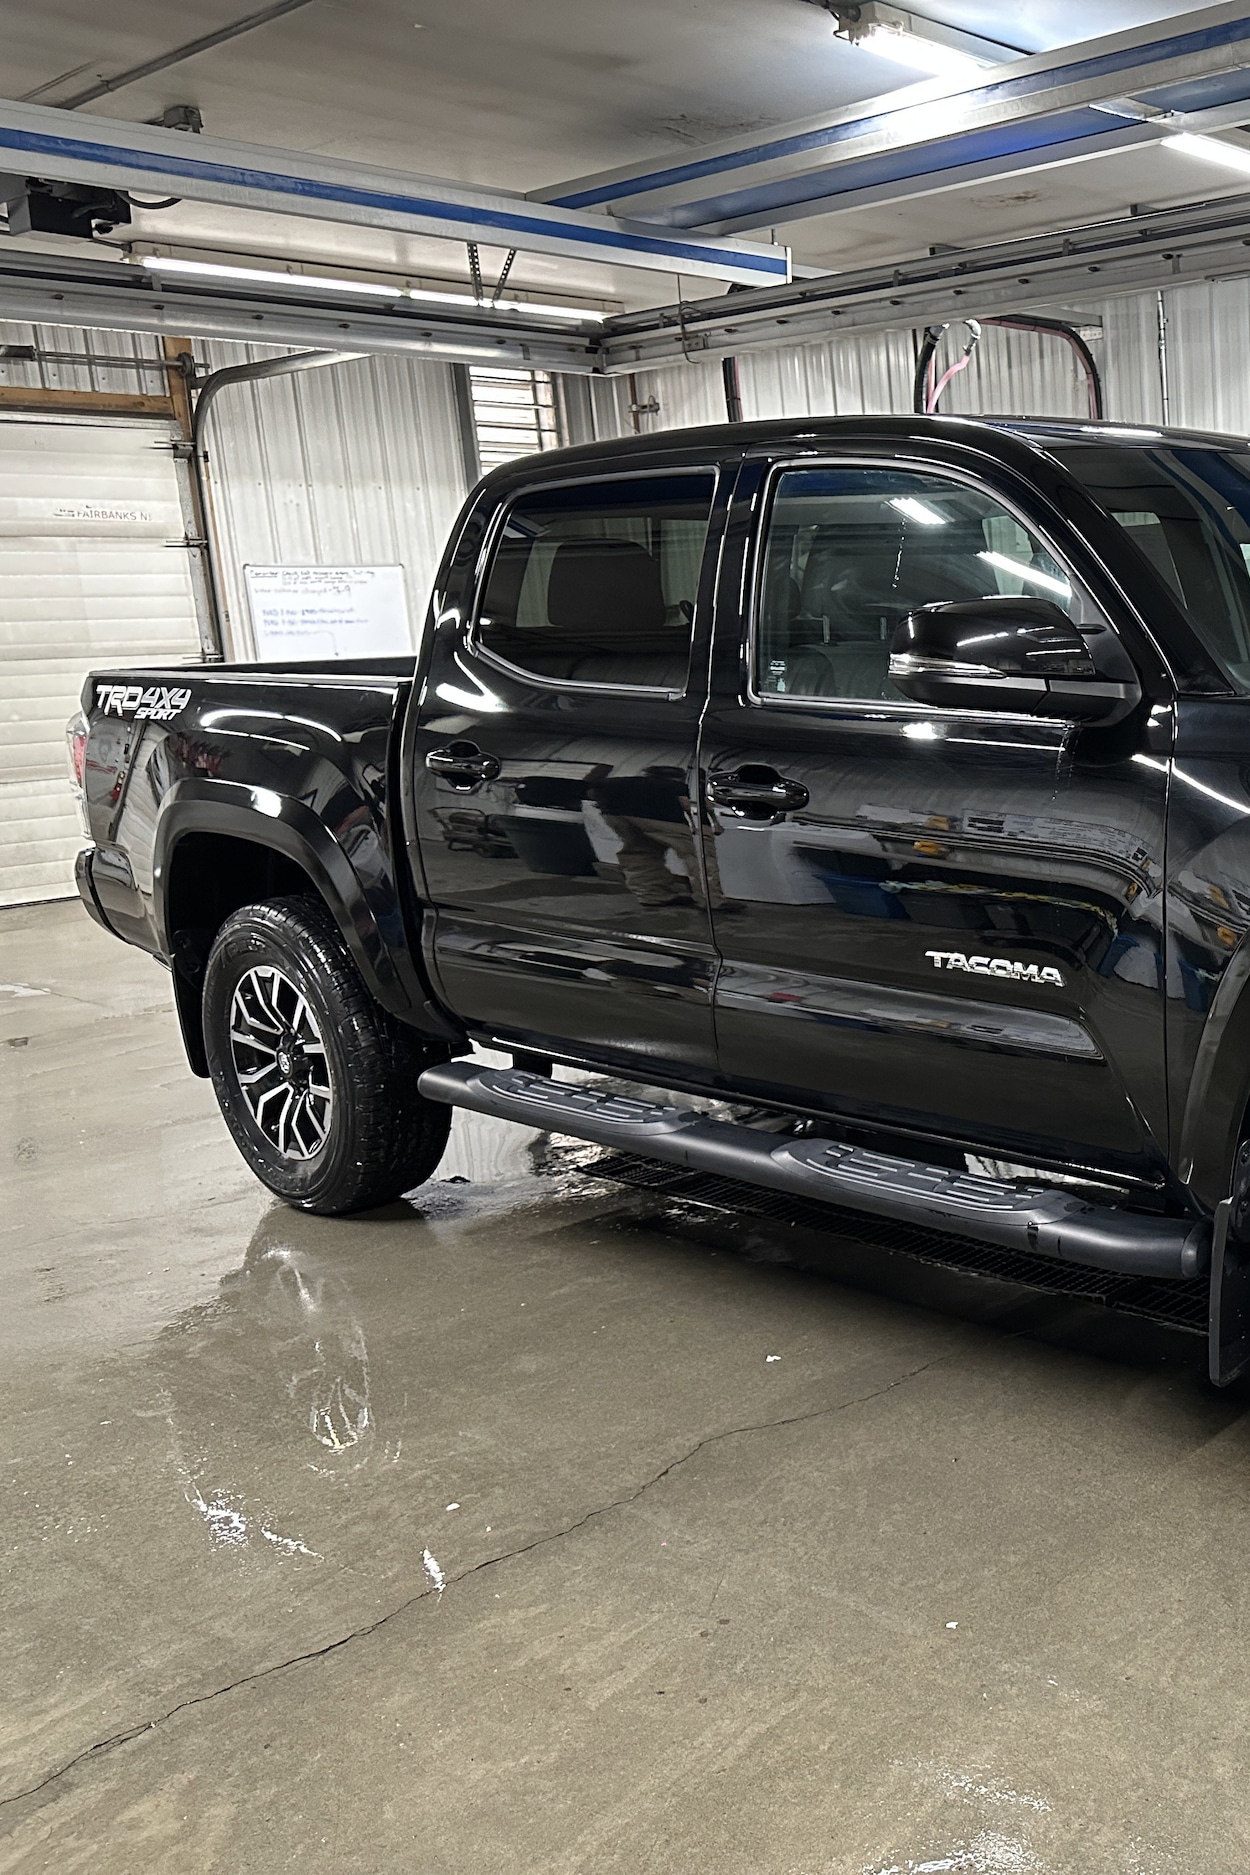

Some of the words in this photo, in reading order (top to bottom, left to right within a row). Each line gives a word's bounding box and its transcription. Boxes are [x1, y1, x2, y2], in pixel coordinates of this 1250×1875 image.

[77, 510, 137, 521] FAIRBANKS
[96, 684, 143, 716] TRD
[133, 707, 182, 721] SPORT
[924, 950, 1066, 988] TACOMA
